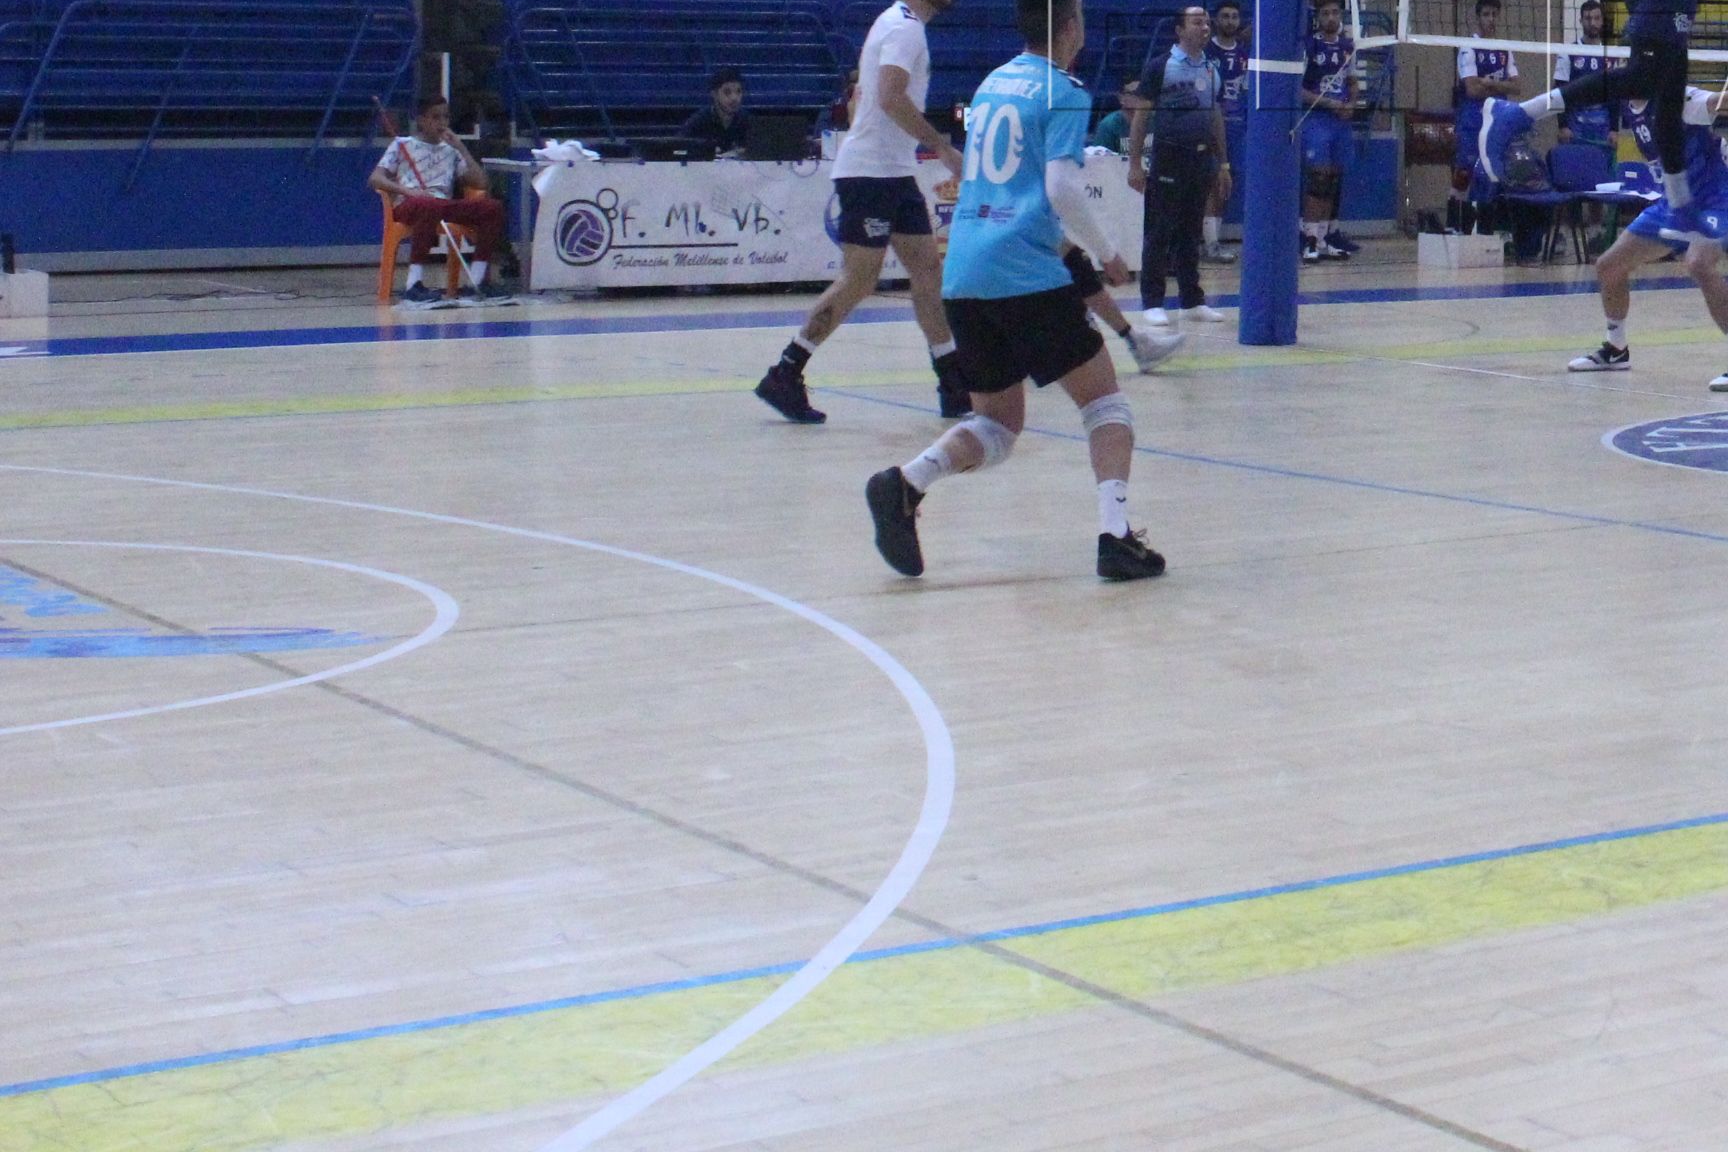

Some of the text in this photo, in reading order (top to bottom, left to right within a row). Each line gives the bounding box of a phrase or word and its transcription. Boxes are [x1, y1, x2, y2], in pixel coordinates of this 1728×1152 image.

[964, 102, 1024, 185] 10
[1636, 124, 1652, 144] 19
[612, 251, 789, 270] Federación Melillense de Voleibol
